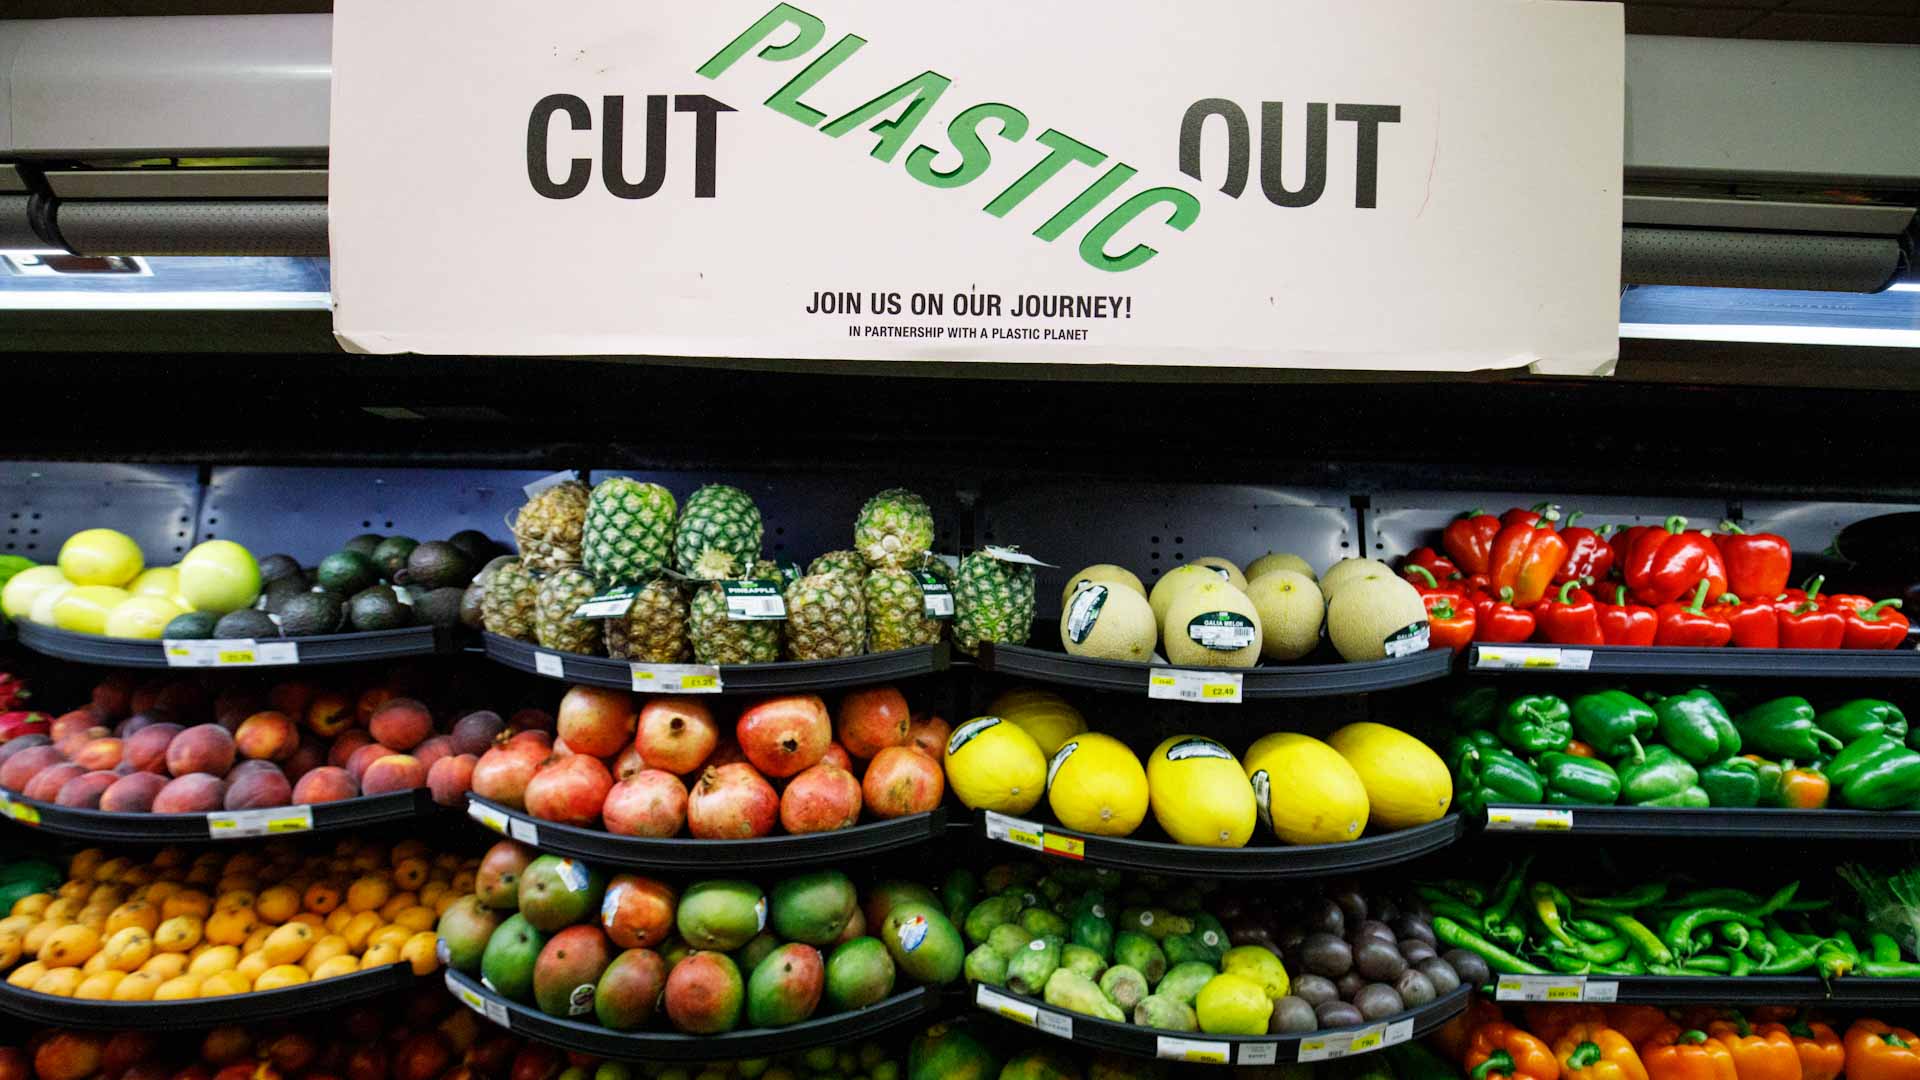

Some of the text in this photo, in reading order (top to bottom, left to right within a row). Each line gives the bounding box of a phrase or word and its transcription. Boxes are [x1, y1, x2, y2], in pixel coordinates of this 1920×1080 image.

[527, 93, 739, 199] CUT
[695, 2, 1201, 272] PLASTIC
[1179, 97, 1401, 209] OUT
[806, 291, 1132, 319] JOIN US ON OUR JOURNEY!
[849, 325, 1088, 341] IN PARTNERSHIP WITH A PLASTIC PLANET
